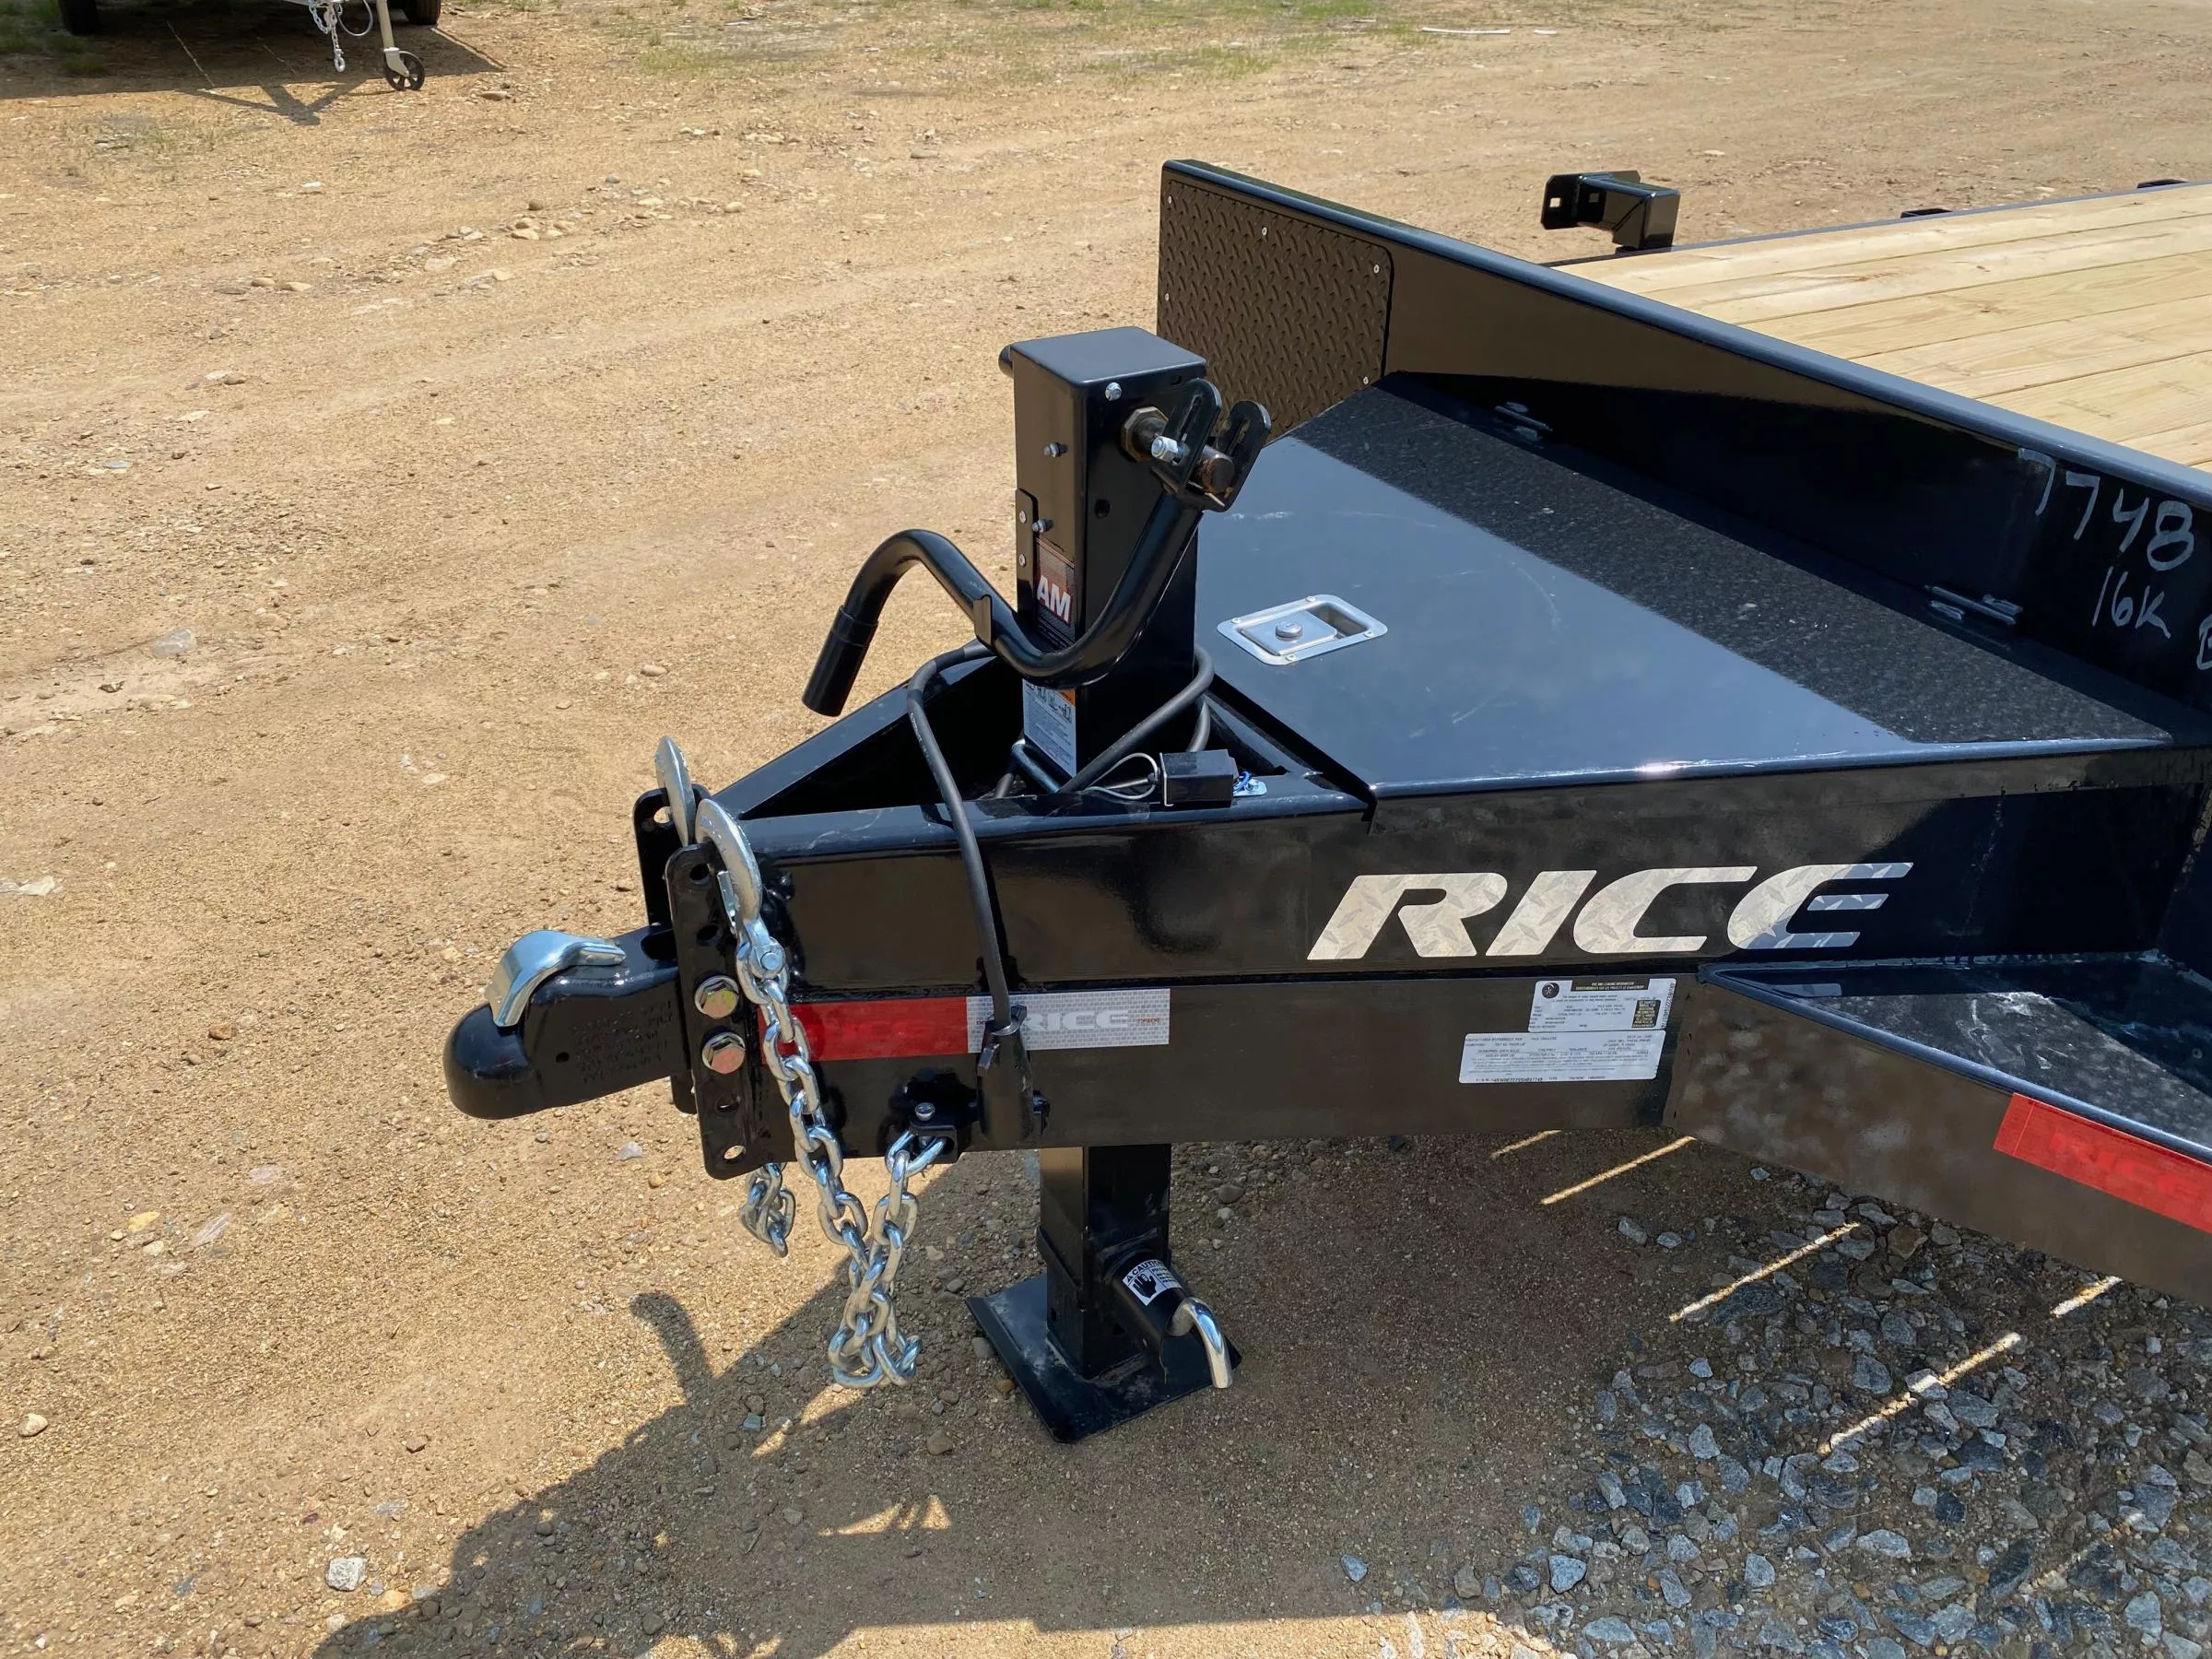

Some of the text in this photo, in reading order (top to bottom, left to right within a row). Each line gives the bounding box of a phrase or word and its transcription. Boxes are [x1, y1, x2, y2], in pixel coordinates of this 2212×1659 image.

[2018, 448, 2194, 571] 7748
[2092, 566, 2171, 640] 16K
[1306, 862, 1914, 960] RICE
